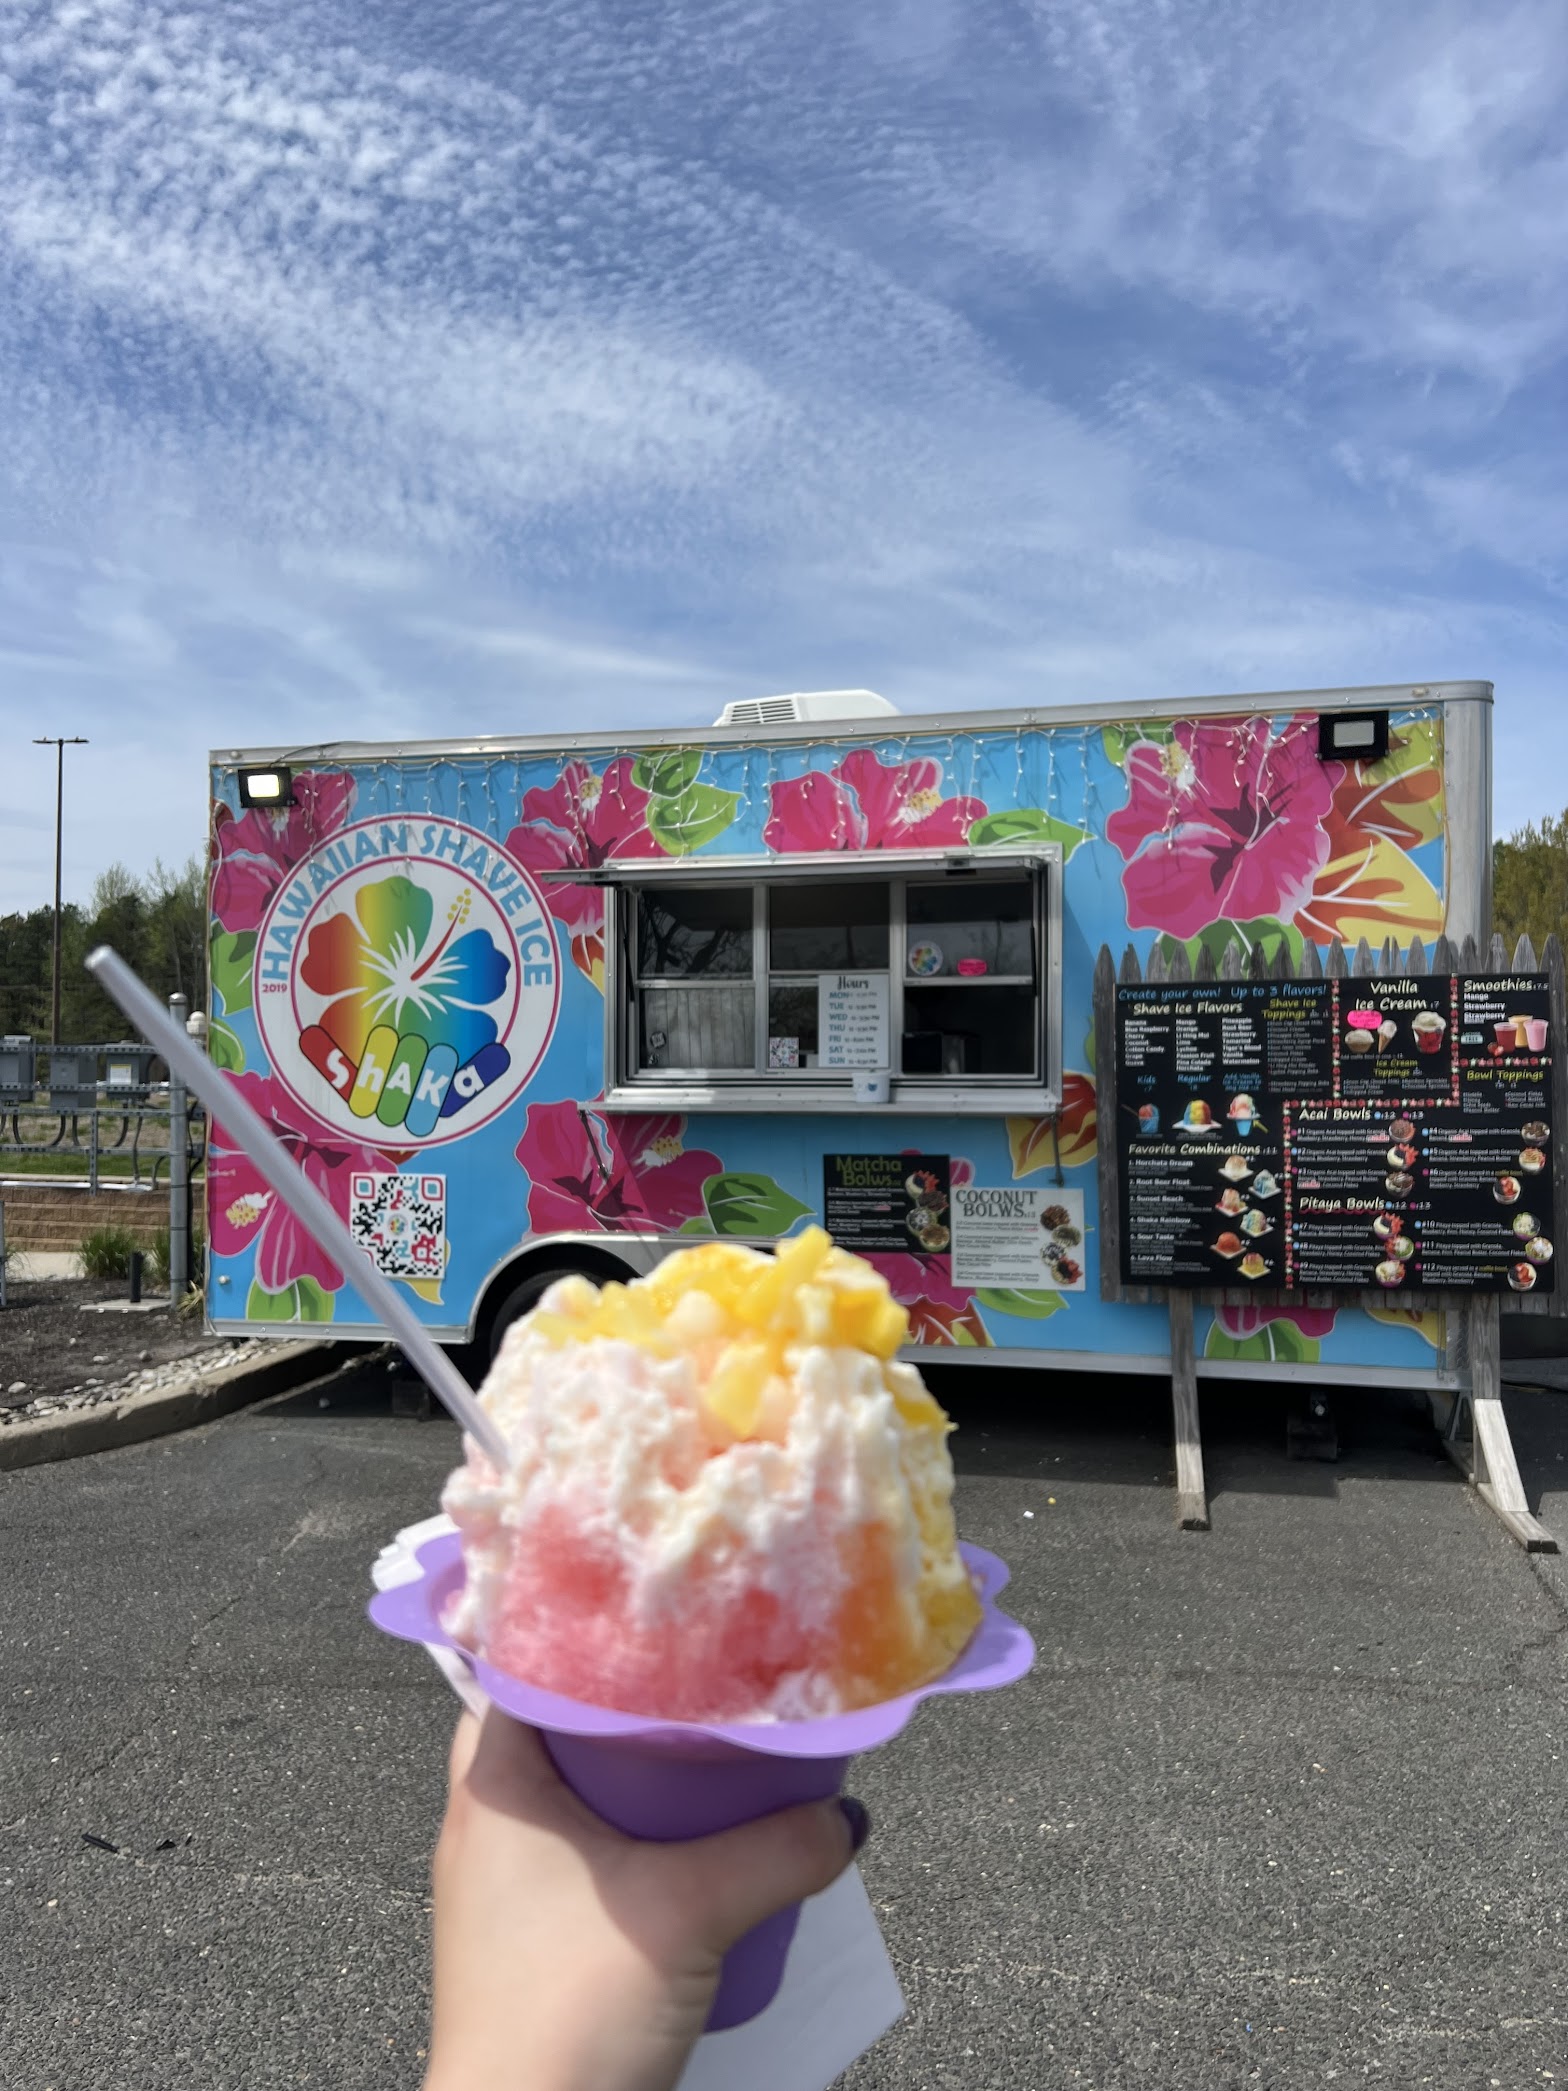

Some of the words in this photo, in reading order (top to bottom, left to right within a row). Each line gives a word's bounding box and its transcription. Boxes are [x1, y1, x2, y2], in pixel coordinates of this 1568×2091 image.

[262, 823, 407, 981] HAWAIIAN
[420, 824, 533, 916] SHAVE
[514, 918, 552, 986] ICE
[262, 983, 288, 995] 2019
[837, 976, 870, 990] Hours
[1370, 979, 1418, 995] Vanilla
[1464, 978, 1533, 993] Smoothies
[1118, 988, 1157, 1002] Create
[1161, 989, 1189, 1003] your
[1192, 986, 1220, 999] own!
[1231, 986, 1248, 1000] Up
[1252, 986, 1265, 997] to
[1270, 985, 1278, 997] 3
[1282, 983, 1327, 997] flavors!
[1464, 993, 1489, 1001] Mango
[829, 1002, 844, 1010] TUE
[1133, 1001, 1170, 1016] Shave
[1175, 1001, 1192, 1014] Ice
[1197, 1000, 1243, 1015] Flavors
[1269, 998, 1299, 1008] Shave
[1302, 997, 1317, 1008] Ice
[1355, 998, 1374, 1010] Ice
[1379, 996, 1427, 1011] Cream
[1464, 1002, 1506, 1011] Strawberry
[829, 1013, 848, 1021] WED
[1262, 1009, 1306, 1021] Toppings
[1464, 1012, 1506, 1020] Strawberry
[1389, 1059, 1418, 1067] Cream
[1137, 1075, 1157, 1085] Kids
[1177, 1073, 1212, 1084] Regular
[1374, 1068, 1410, 1079] Toppings
[1466, 1069, 1493, 1080] Bowl
[1495, 1069, 1544, 1083] Toppings
[1299, 1106, 1329, 1121] Acai
[1333, 1106, 1371, 1121] Bowls
[1129, 1143, 1176, 1155] Favorite
[1180, 1141, 1261, 1156] Combinations
[836, 1156, 902, 1172] Matcha
[1169, 1159, 1194, 1167] Dream
[843, 1169, 891, 1186] Bolws
[1136, 1177, 1153, 1185] Root
[956, 1190, 1038, 1205] COCONUT
[1299, 1196, 1341, 1212] Pitaya
[1346, 1196, 1385, 1210] Bowls
[963, 1203, 1024, 1218] BOLWS
